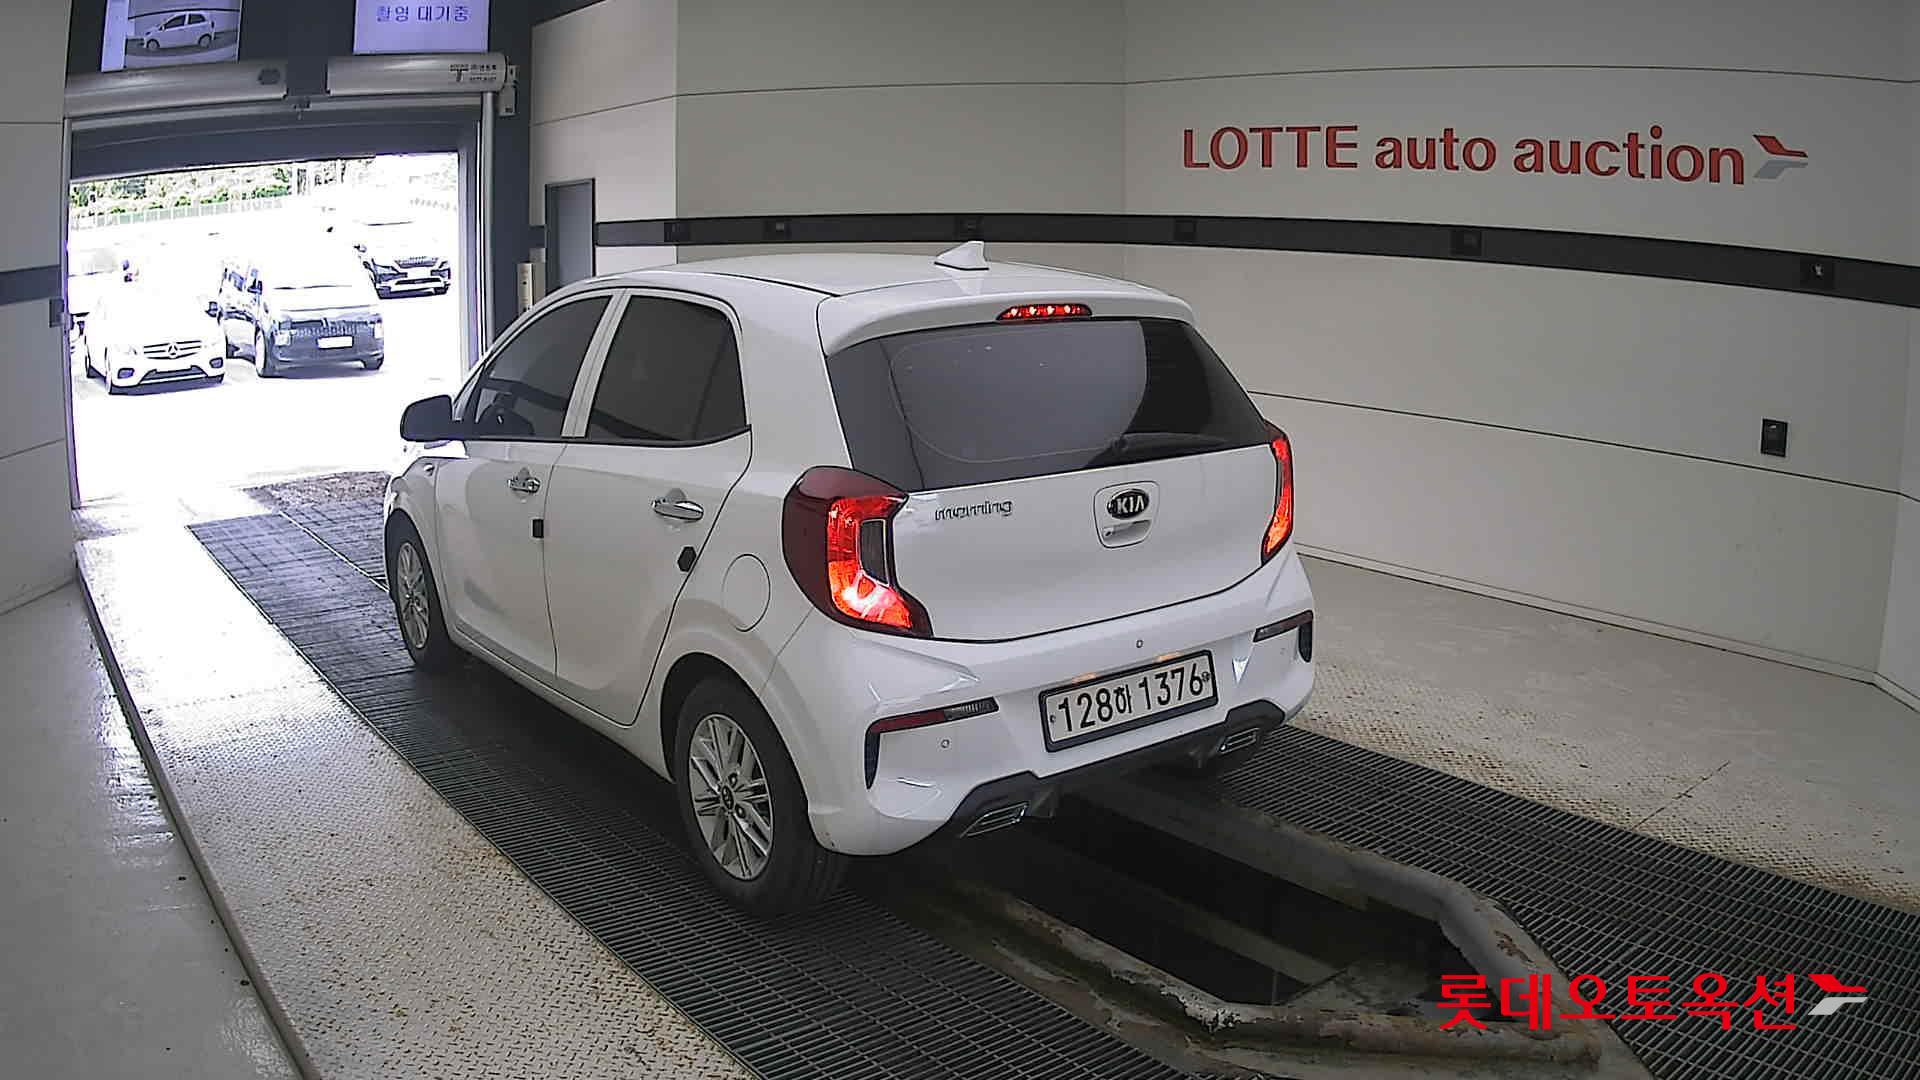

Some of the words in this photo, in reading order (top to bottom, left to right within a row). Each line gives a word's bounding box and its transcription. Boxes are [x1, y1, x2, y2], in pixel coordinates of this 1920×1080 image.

[418, 6, 469, 21] 대기중
[1183, 125, 1358, 170] LOTTE
[1375, 128, 1497, 171] auto
[1513, 125, 1745, 185] auction
[1116, 495, 1147, 515] KIA
[1058, 684, 1133, 732] 128하
[1138, 663, 1204, 710] 1376
